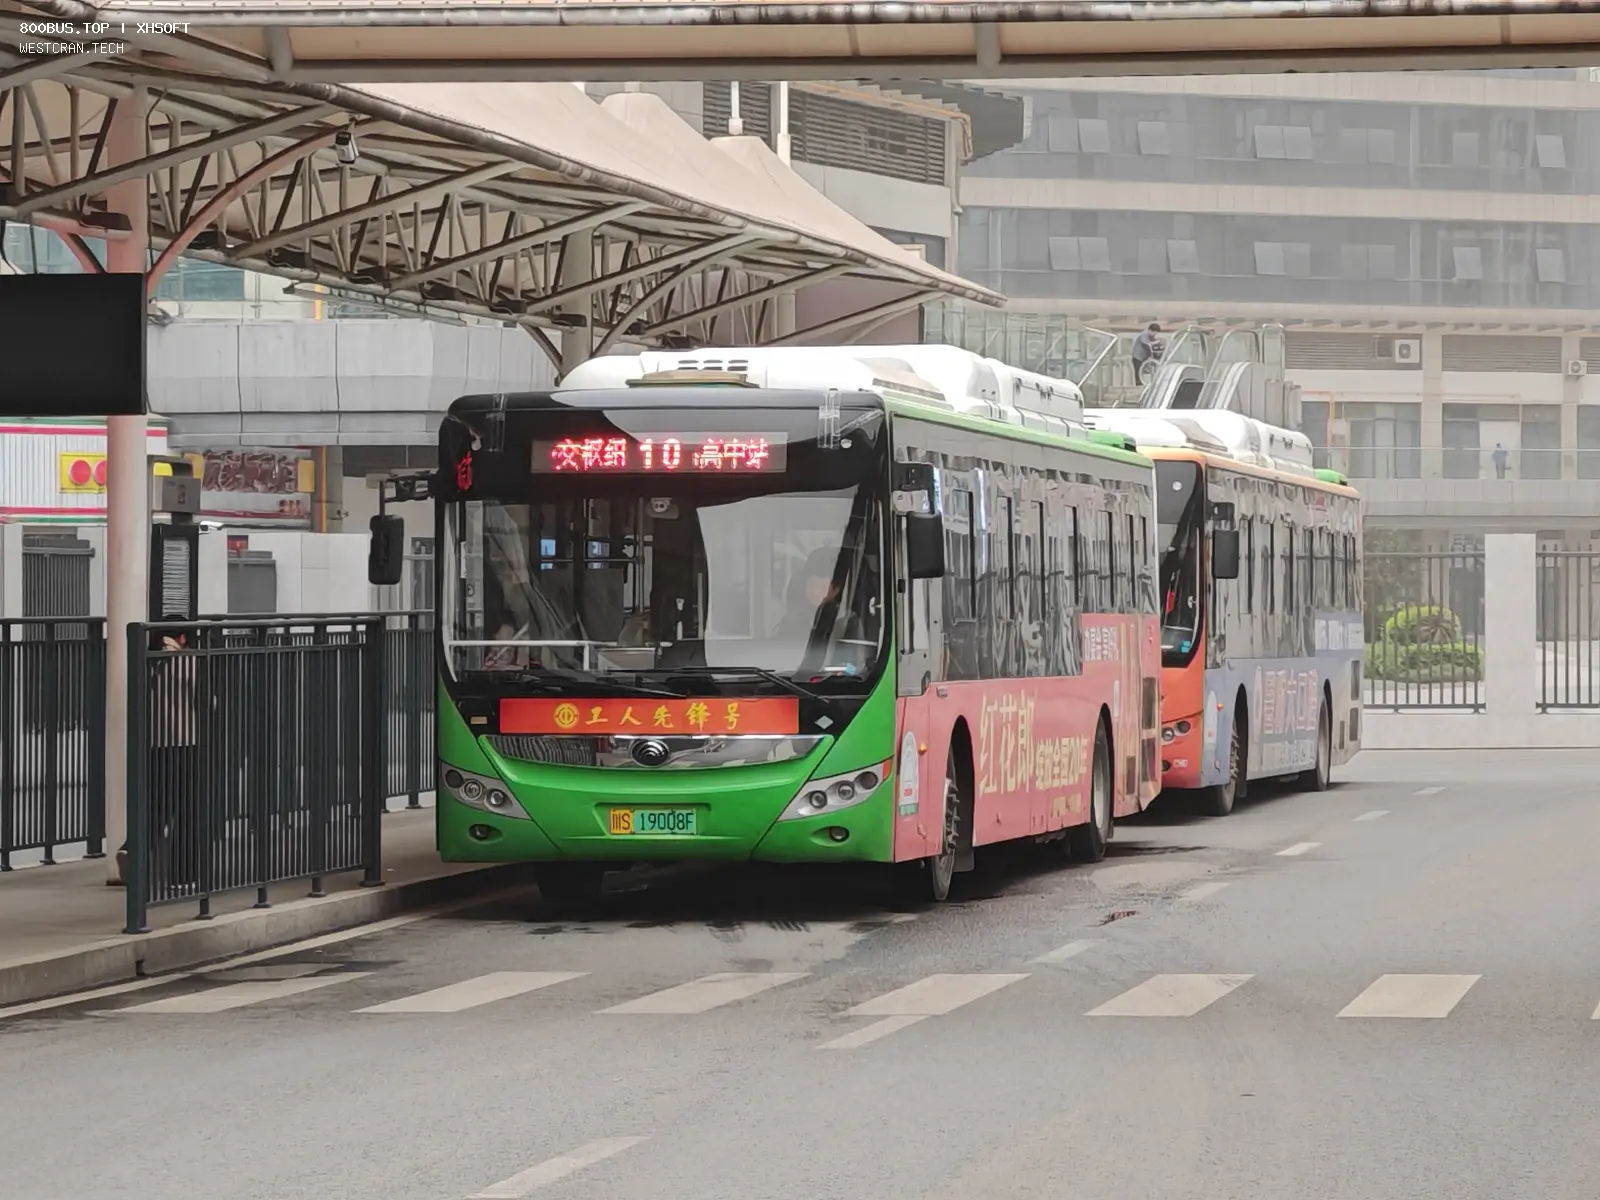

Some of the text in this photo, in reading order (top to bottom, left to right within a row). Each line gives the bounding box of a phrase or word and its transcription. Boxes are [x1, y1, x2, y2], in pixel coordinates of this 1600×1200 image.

[640, 438, 681, 469] 10
[585, 702, 741, 733] 工人先锋号
[979, 689, 1036, 799] 红花郎
